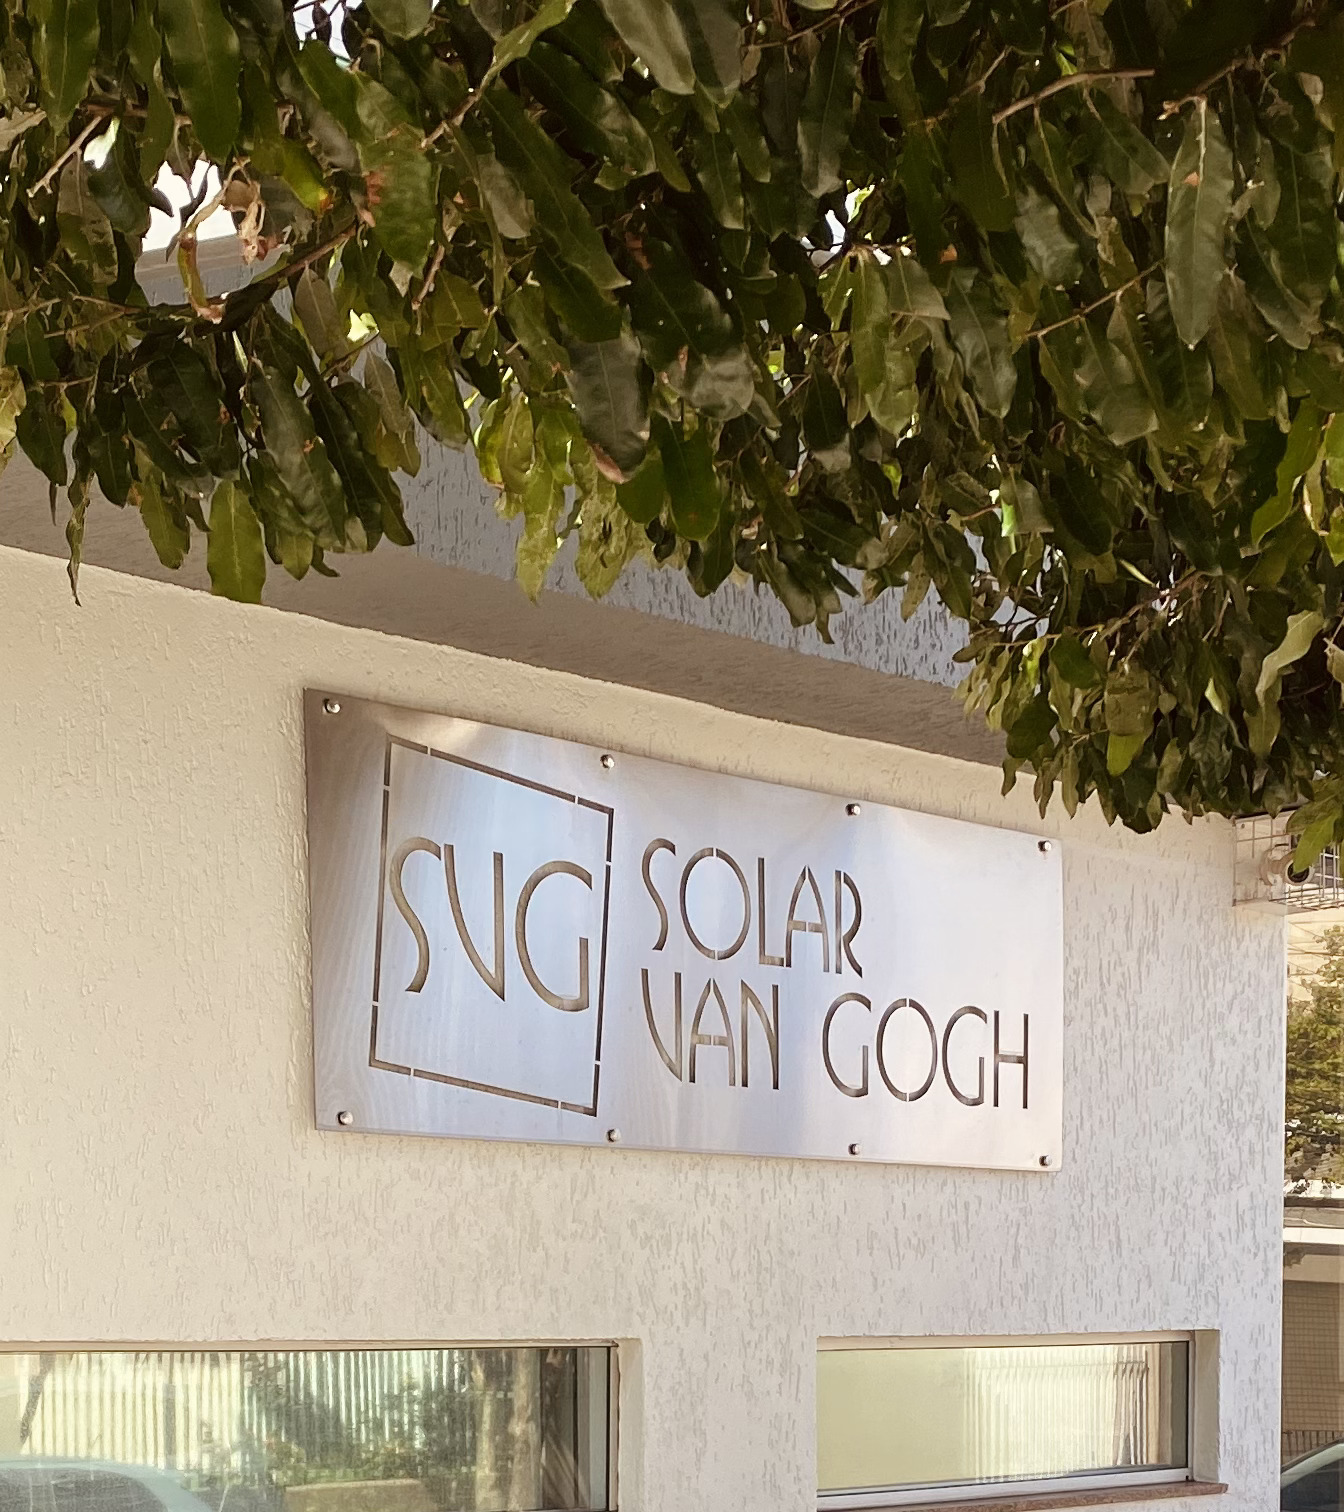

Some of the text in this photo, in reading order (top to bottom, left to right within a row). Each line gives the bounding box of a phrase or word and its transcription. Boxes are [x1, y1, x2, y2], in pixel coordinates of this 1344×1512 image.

[389, 837, 593, 1011] SVG
[642, 838, 863, 979] SOLAR
[640, 967, 1030, 1110] VAN GOGH
